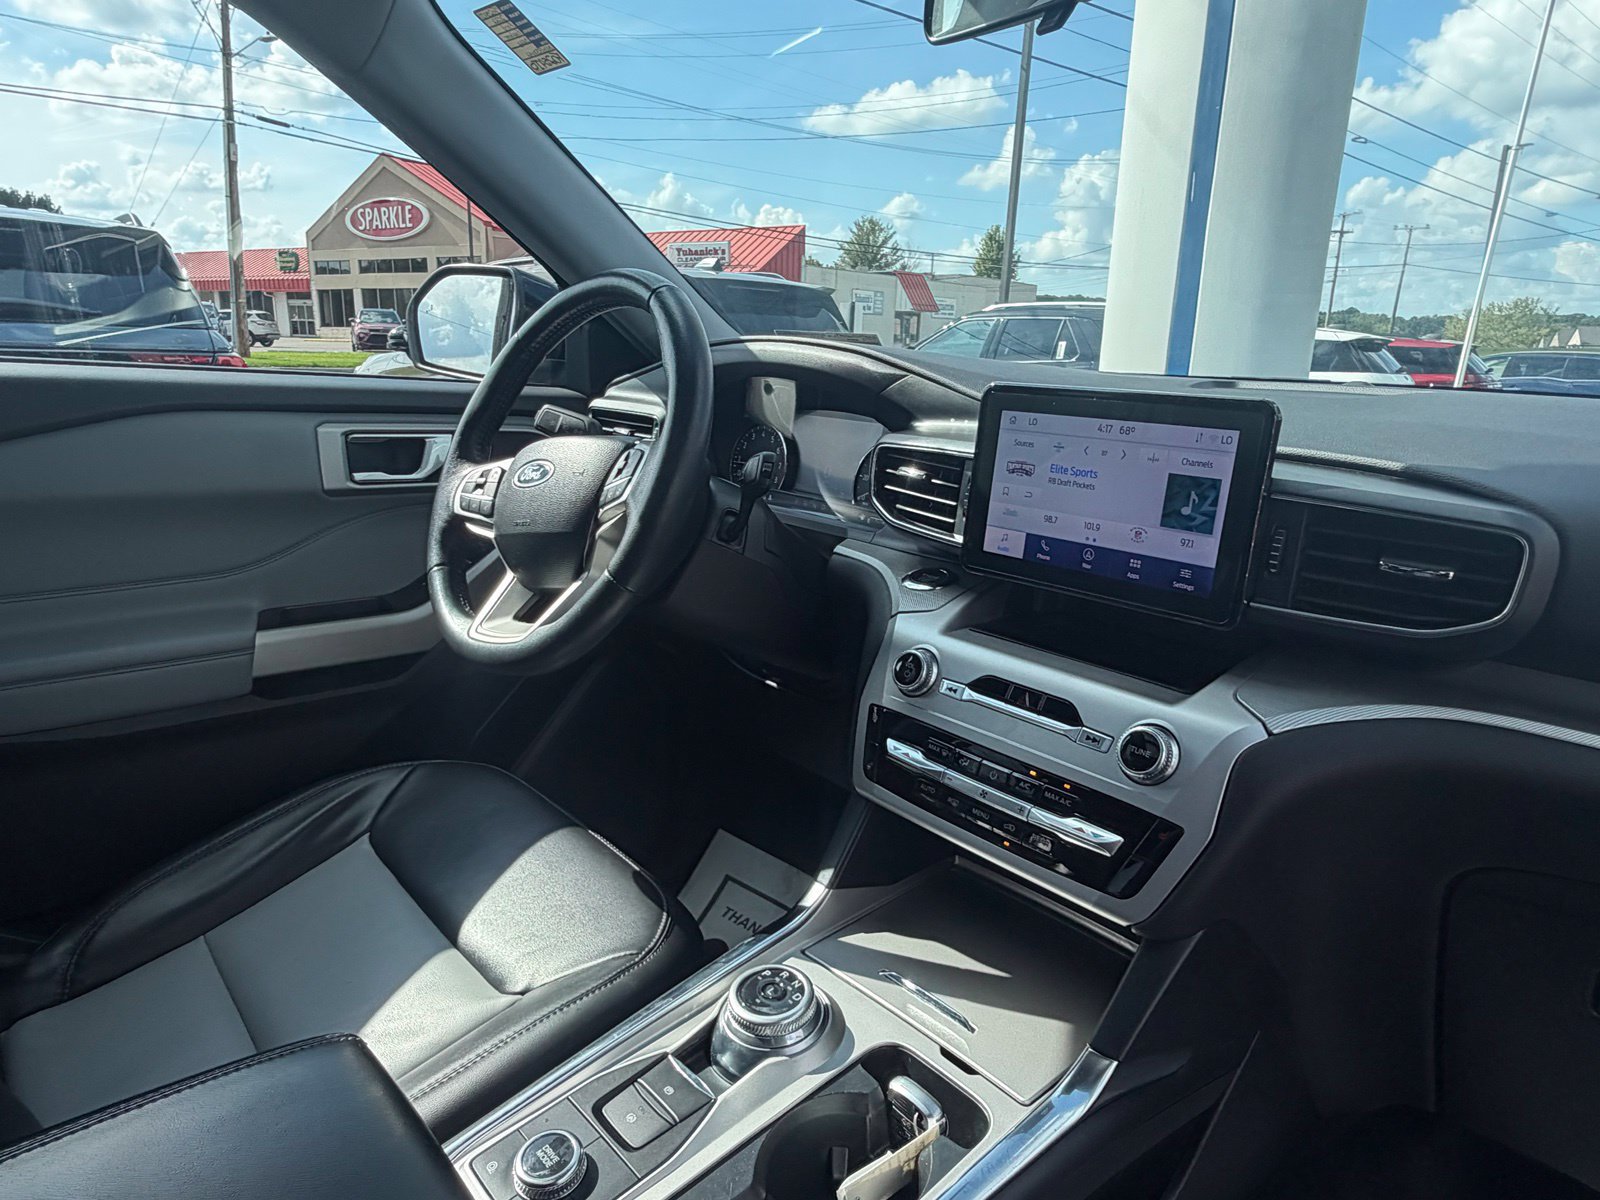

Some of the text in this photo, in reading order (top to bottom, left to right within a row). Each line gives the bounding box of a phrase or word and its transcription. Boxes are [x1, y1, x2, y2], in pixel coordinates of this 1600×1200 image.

[357, 205, 413, 230] SPARKLE
[676, 247, 726, 256] Yuhanick's
[1028, 417, 1038, 426] LO
[1097, 423, 1113, 434] 4:17
[1014, 438, 1035, 449] Sources
[1220, 435, 1233, 445] LO
[1181, 457, 1214, 469] Channels
[1050, 463, 1099, 479] Elite Sports
[1057, 478, 1072, 487] Draft
[1072, 480, 1096, 491] Pockets
[1043, 514, 1058, 524] 98.7
[1084, 521, 1101, 532] 101.9
[1127, 571, 1140, 580] Apps
[1172, 581, 1195, 592] Settings
[1130, 745, 1152, 759] TUNE
[1044, 791, 1059, 802] MAX
[779, 971, 789, 979] R
[791, 980, 802, 988] N
[767, 986, 775, 996] L
[792, 992, 802, 1001] D
[535, 1149, 553, 1168] MODE
[542, 1144, 560, 1164] DRIVE
